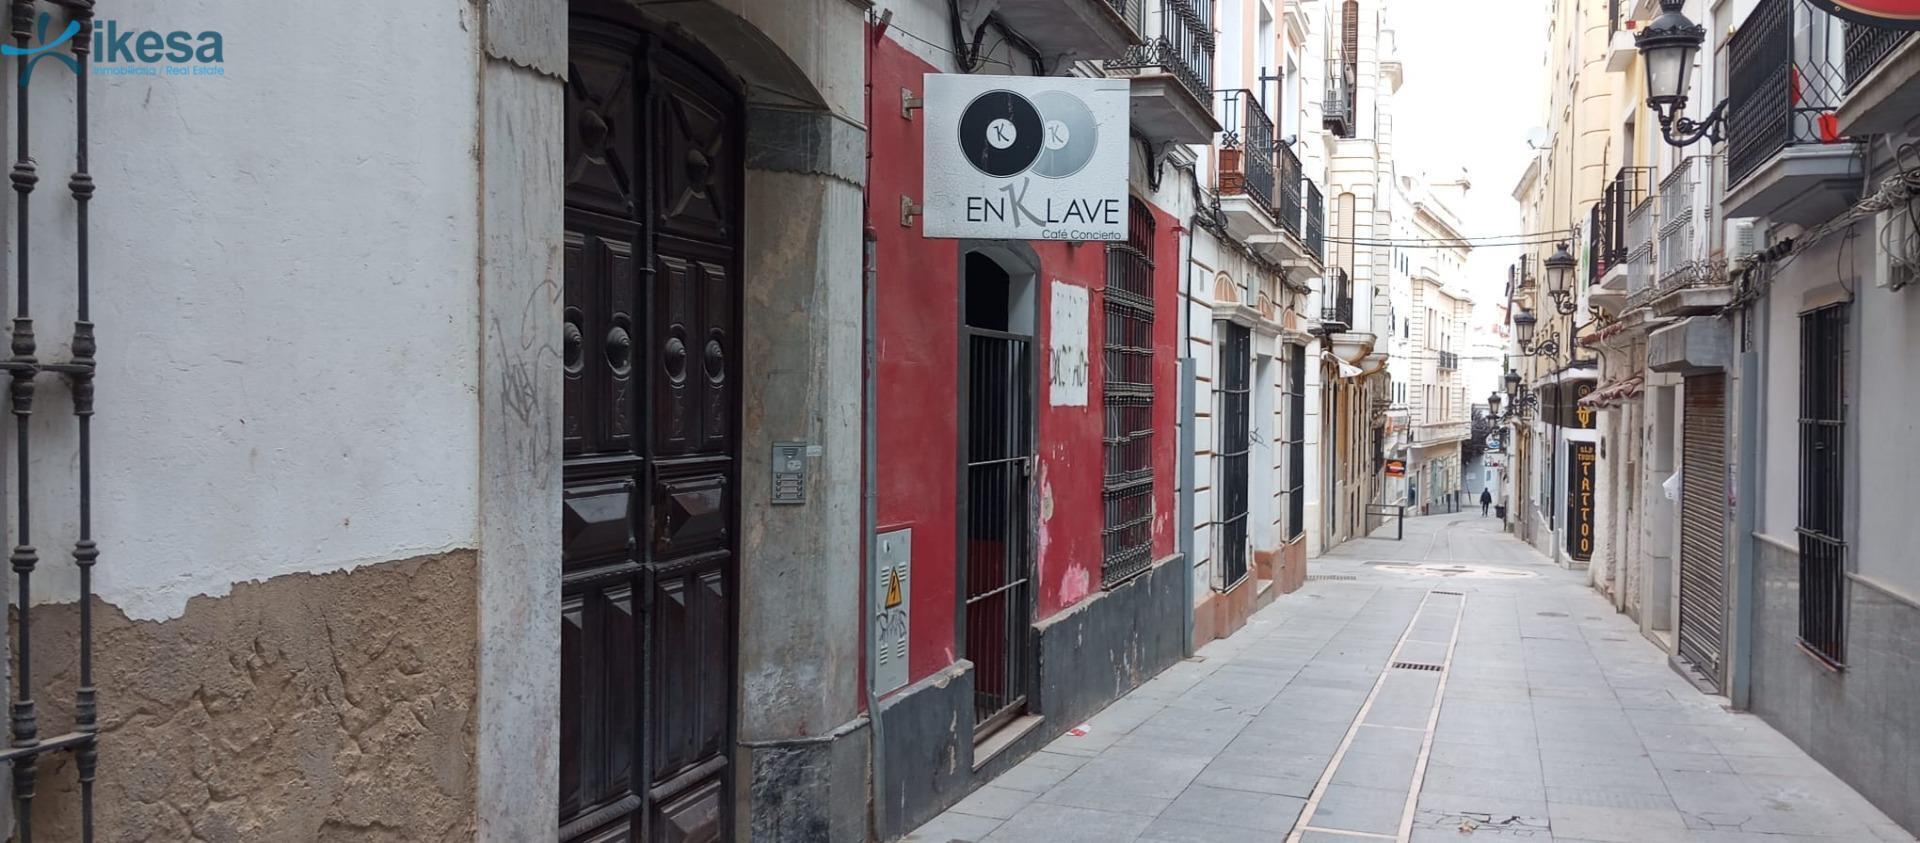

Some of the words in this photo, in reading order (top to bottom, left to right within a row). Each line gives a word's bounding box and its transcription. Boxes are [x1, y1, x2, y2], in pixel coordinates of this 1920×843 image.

[993, 122, 1010, 143] K
[1042, 229, 1068, 239] Café
[1070, 229, 1121, 240] Concierto
[1580, 461, 1592, 552] TATTOO
